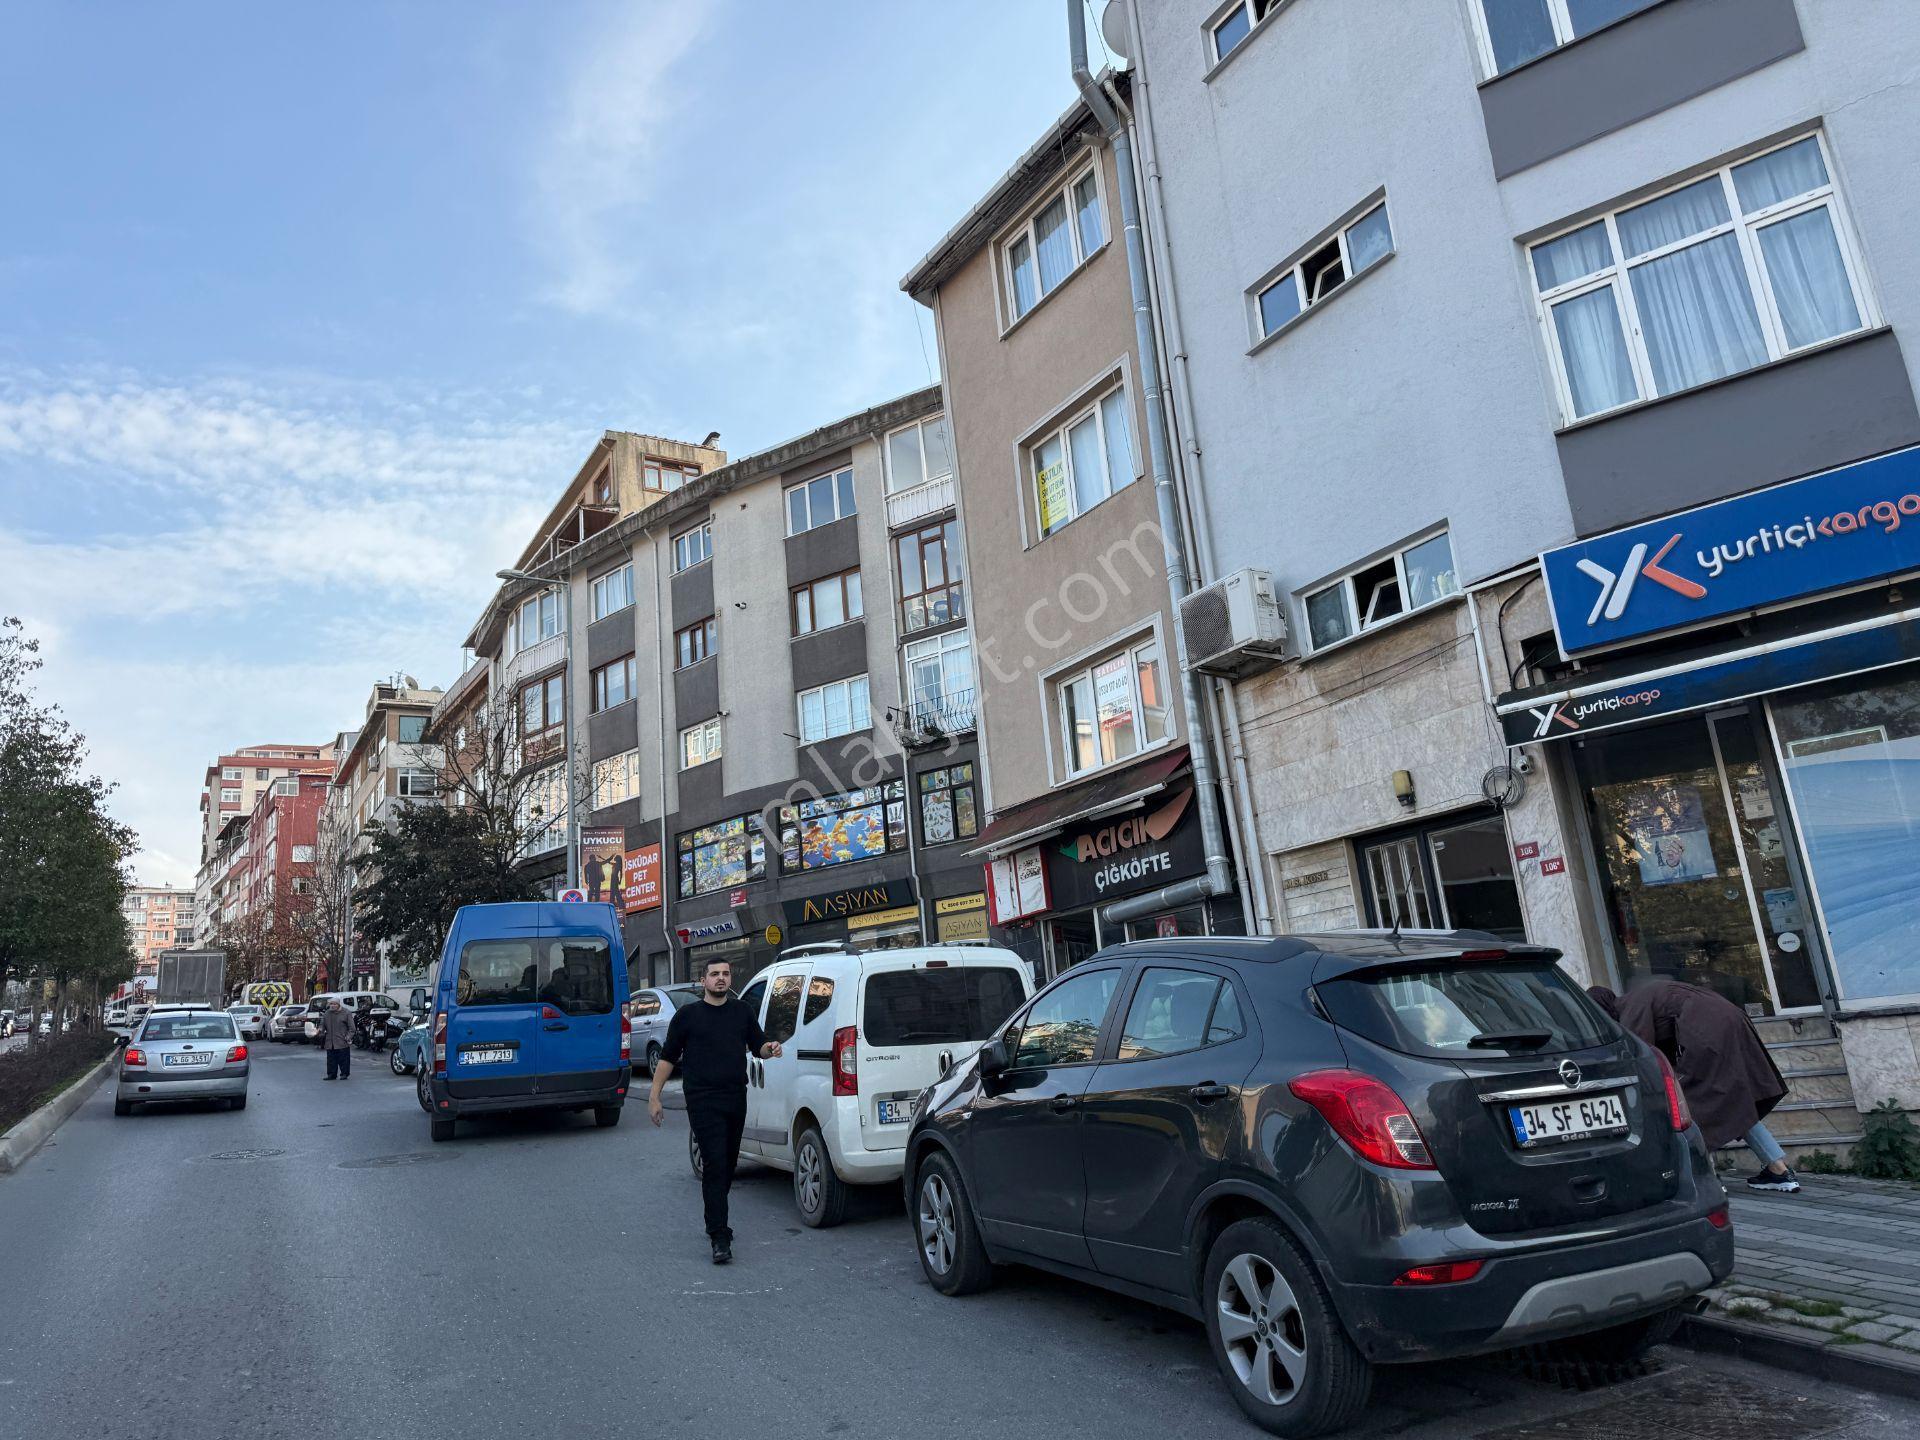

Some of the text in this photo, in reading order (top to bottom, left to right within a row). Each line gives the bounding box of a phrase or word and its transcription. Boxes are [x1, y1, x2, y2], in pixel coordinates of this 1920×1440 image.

[1096, 659, 1126, 677] SATILIK
[1573, 689, 1661, 721] yurtiçikargo
[582, 836, 623, 845] UYKUCU
[633, 869, 648, 883] PET
[1094, 851, 1172, 893] ÇİĞKÖFTE
[625, 881, 656, 898] CENTER
[824, 887, 889, 915] AŞİYAN
[851, 913, 880, 928] AŞİYAN
[945, 917, 983, 934] AŞİYAN
[690, 928, 712, 939] TUNA
[464, 1050, 511, 1061] 34 YT 7313
[887, 1103, 900, 1117] 34
[1523, 1100, 1622, 1136] 34 SF 6424
[1471, 1202, 1506, 1211] MOKKA
